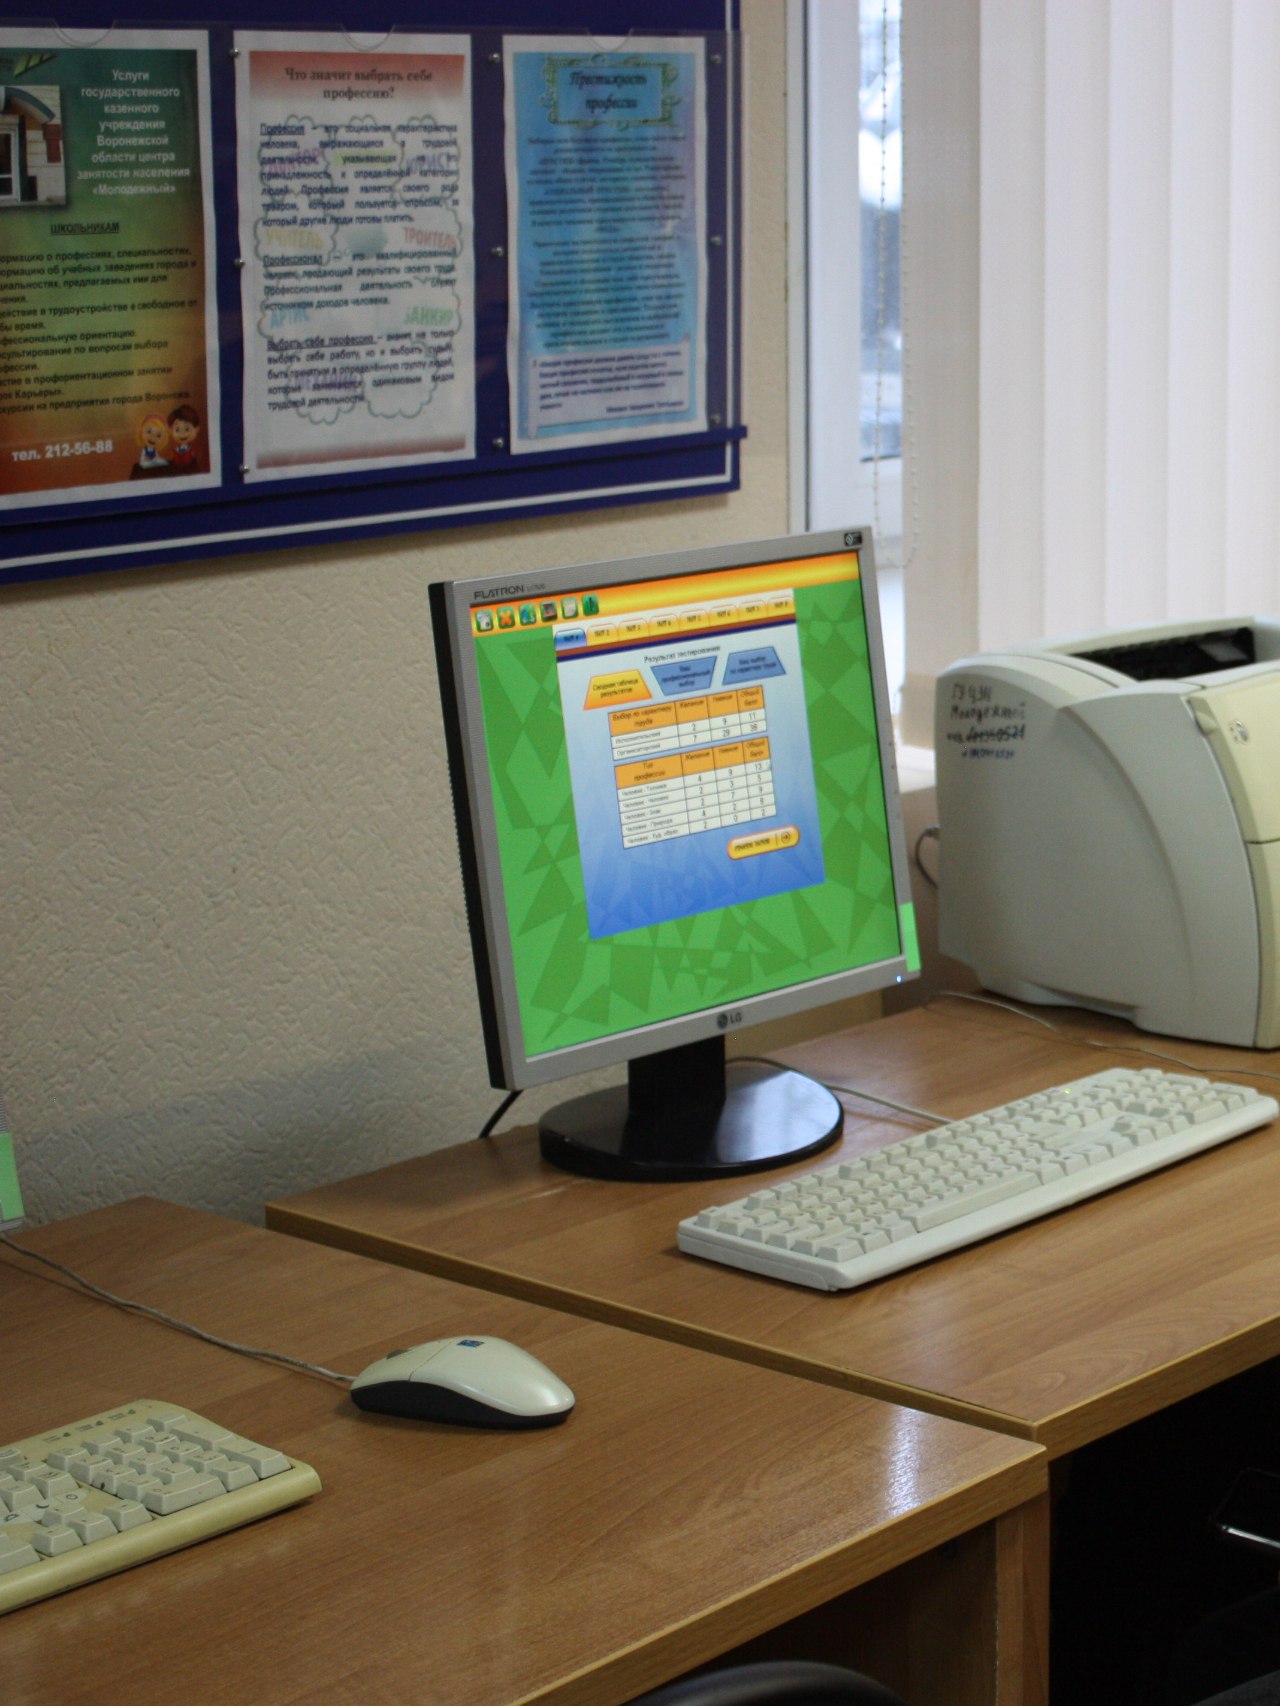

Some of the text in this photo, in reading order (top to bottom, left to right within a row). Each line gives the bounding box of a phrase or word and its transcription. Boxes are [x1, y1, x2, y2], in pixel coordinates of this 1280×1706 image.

[112, 69, 149, 83] Услуги
[285, 68, 307, 81] Что
[81, 88, 180, 99] государственного
[322, 87, 396, 102] профессию?
[104, 104, 159, 114] казенного
[99, 120, 165, 132] учреждения
[97, 135, 168, 147] Воронежской
[91, 151, 175, 164] области центра
[77, 167, 190, 180] занятости населения
[50, 222, 120, 235] ШКОЛЬНИКАМ
[12, 451, 41, 462] тел.
[474, 584, 525, 600] FLATRON
[749, 711, 756, 719] 11
[692, 723, 697, 731] 2
[722, 729, 730, 737] 29
[699, 787, 703, 795] 2
[761, 808, 766, 816] 2
[730, 1012, 743, 1024] LG
